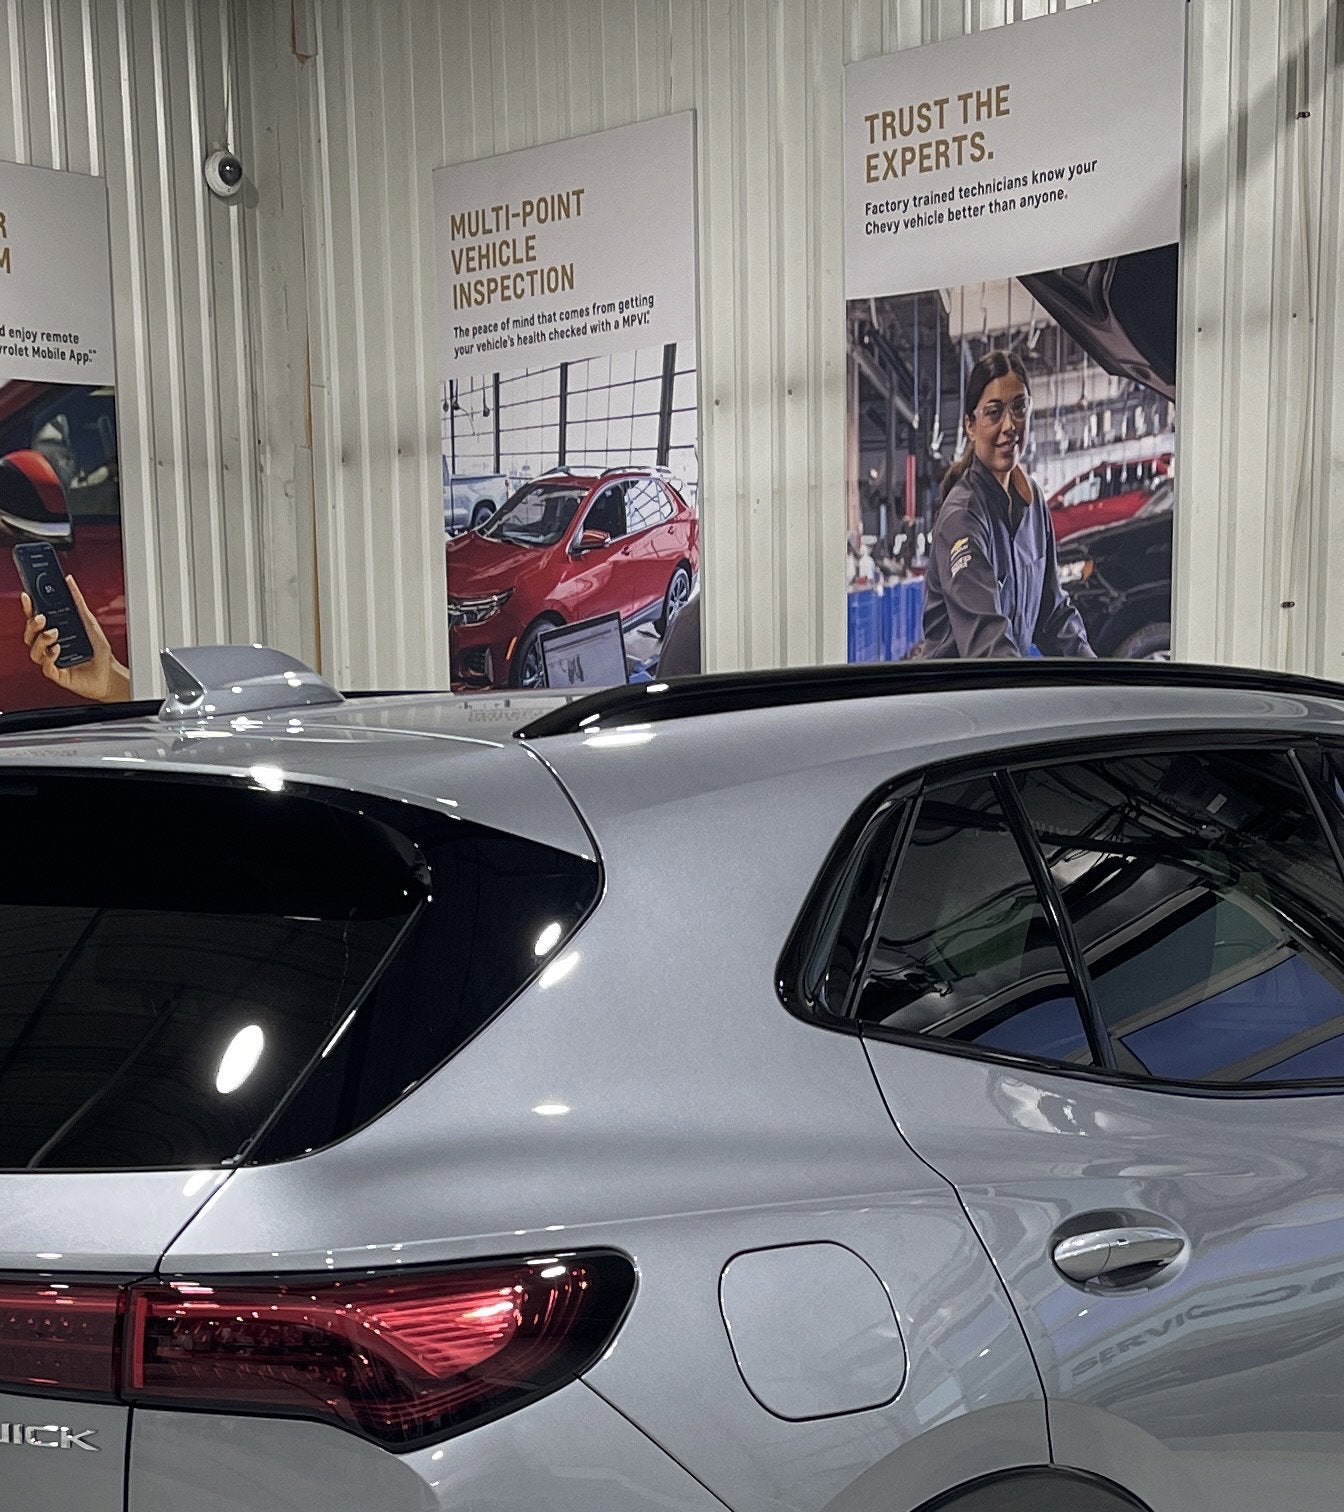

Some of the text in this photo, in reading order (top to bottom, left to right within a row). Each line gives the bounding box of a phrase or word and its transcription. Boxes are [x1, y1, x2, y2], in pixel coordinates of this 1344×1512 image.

[864, 84, 1010, 144] TRUST THE
[865, 131, 994, 184] EXPERTS.
[865, 160, 1098, 216] Factory trained technicians know your
[865, 188, 1069, 235] Chevy vehicle better than anyone.
[450, 188, 585, 241] MULTI-POINT
[451, 234, 537, 275] VEHICLE
[452, 263, 575, 310] INSPECTION
[8, 327, 38, 343] enjoy
[40, 331, 79, 344] remote
[453, 294, 654, 339] The peace of mind that comes from getting
[453, 344, 474, 359] your
[476, 336, 515, 352] vehicle's
[517, 330, 546, 346] health
[548, 322, 587, 341] checked
[589, 318, 611, 334] with
[613, 319, 620, 330] a
[31, 345, 66, 361] Mobile
